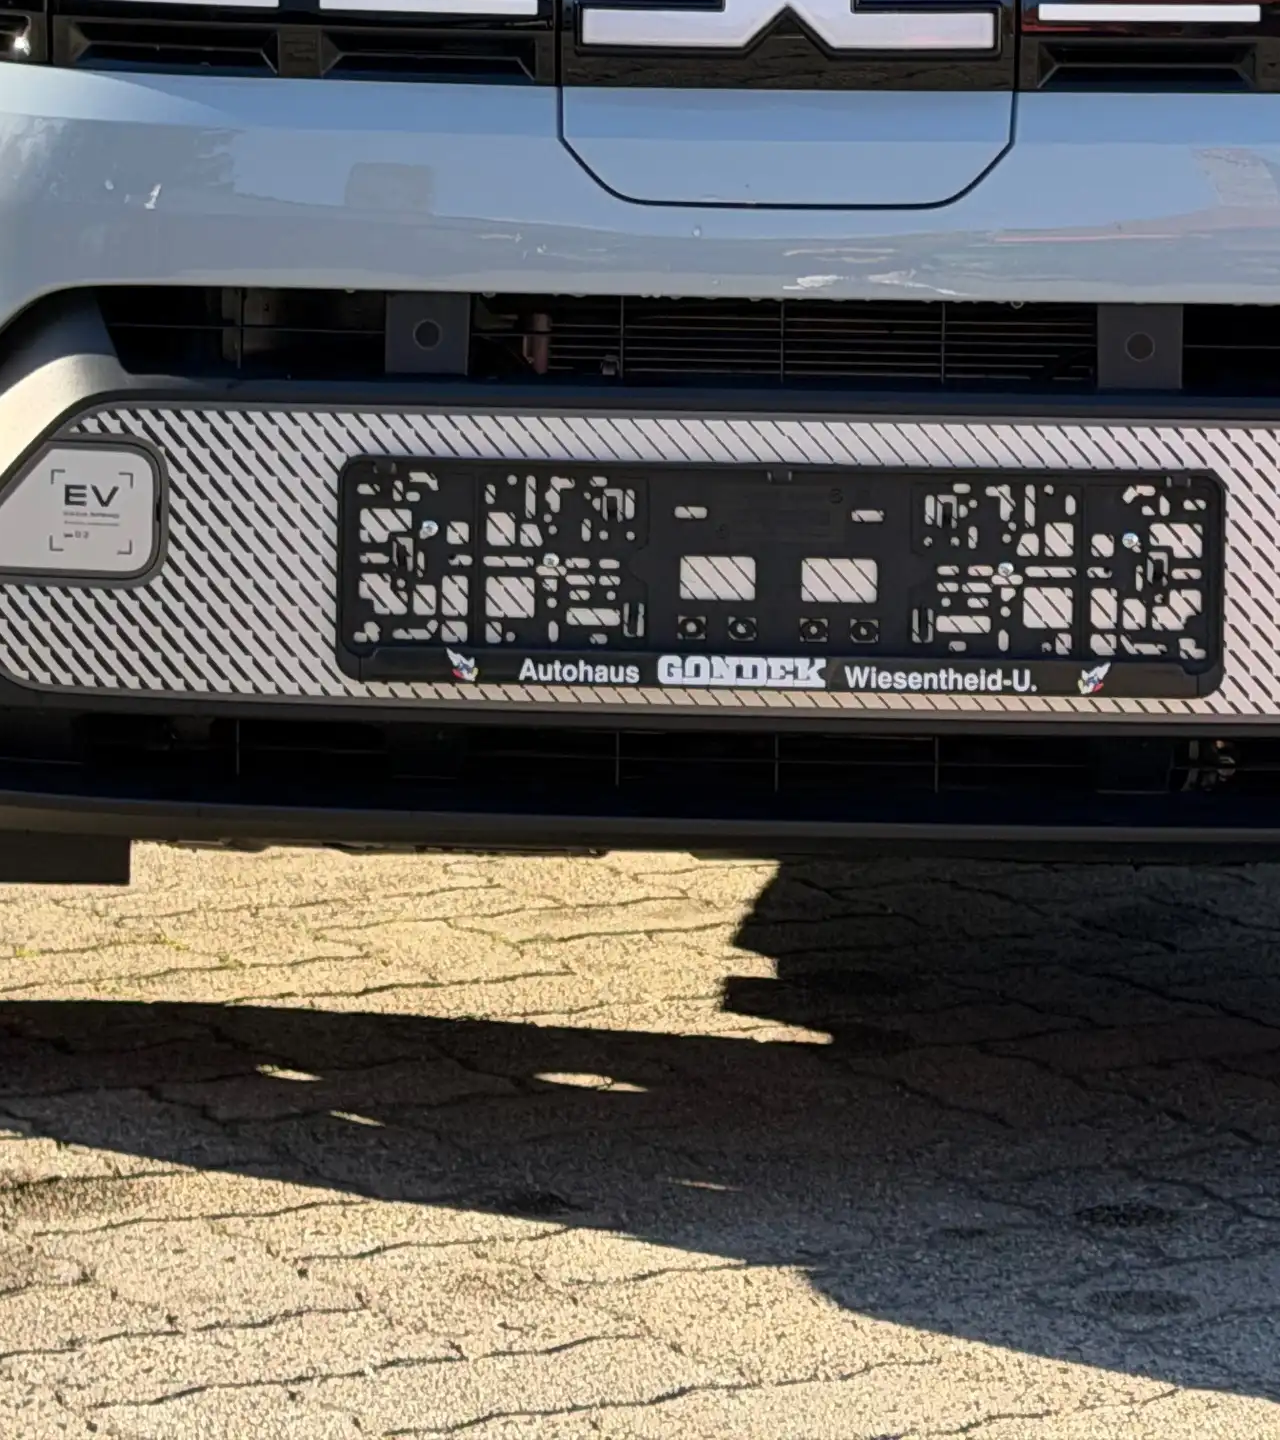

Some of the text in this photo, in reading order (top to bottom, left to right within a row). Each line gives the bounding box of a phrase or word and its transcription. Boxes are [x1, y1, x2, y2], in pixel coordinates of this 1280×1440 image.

[64, 484, 119, 507] EV
[518, 654, 1038, 692] Autohaus GONDEK Wiesentheid-U.
